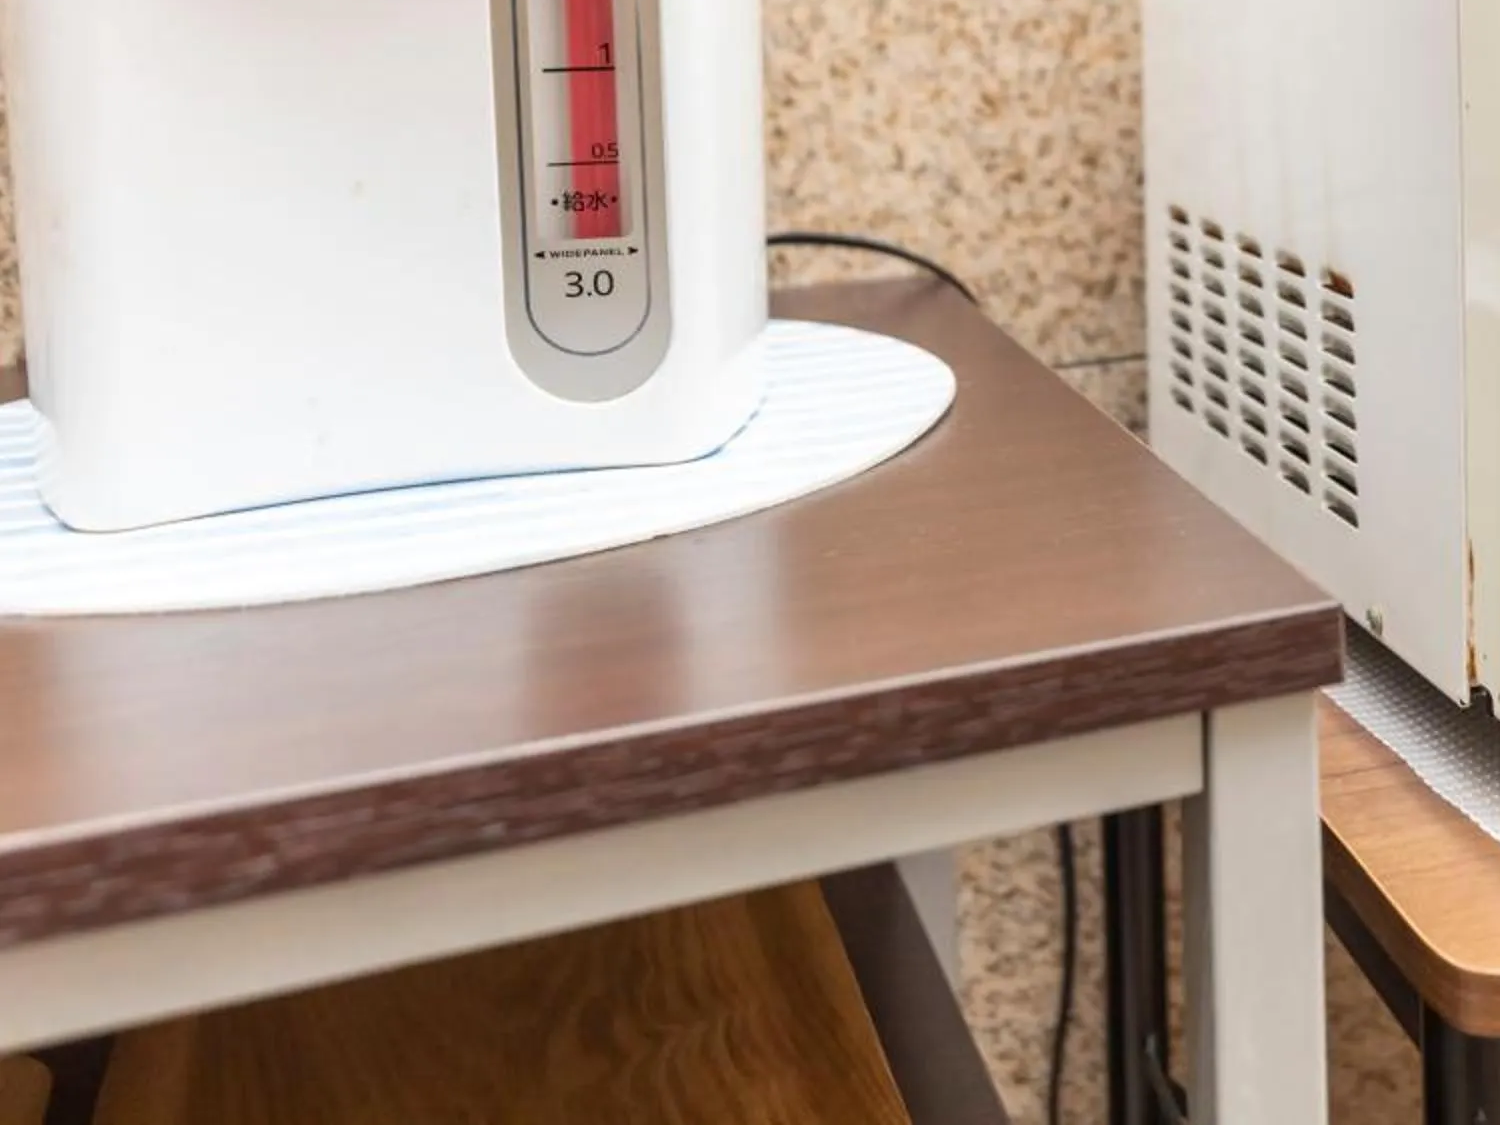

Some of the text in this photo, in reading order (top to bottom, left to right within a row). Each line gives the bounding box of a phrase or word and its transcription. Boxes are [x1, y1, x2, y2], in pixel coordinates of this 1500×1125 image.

[598, 42, 610, 64] 1
[591, 142, 619, 159] 0.5
[564, 269, 615, 298] 3.0
